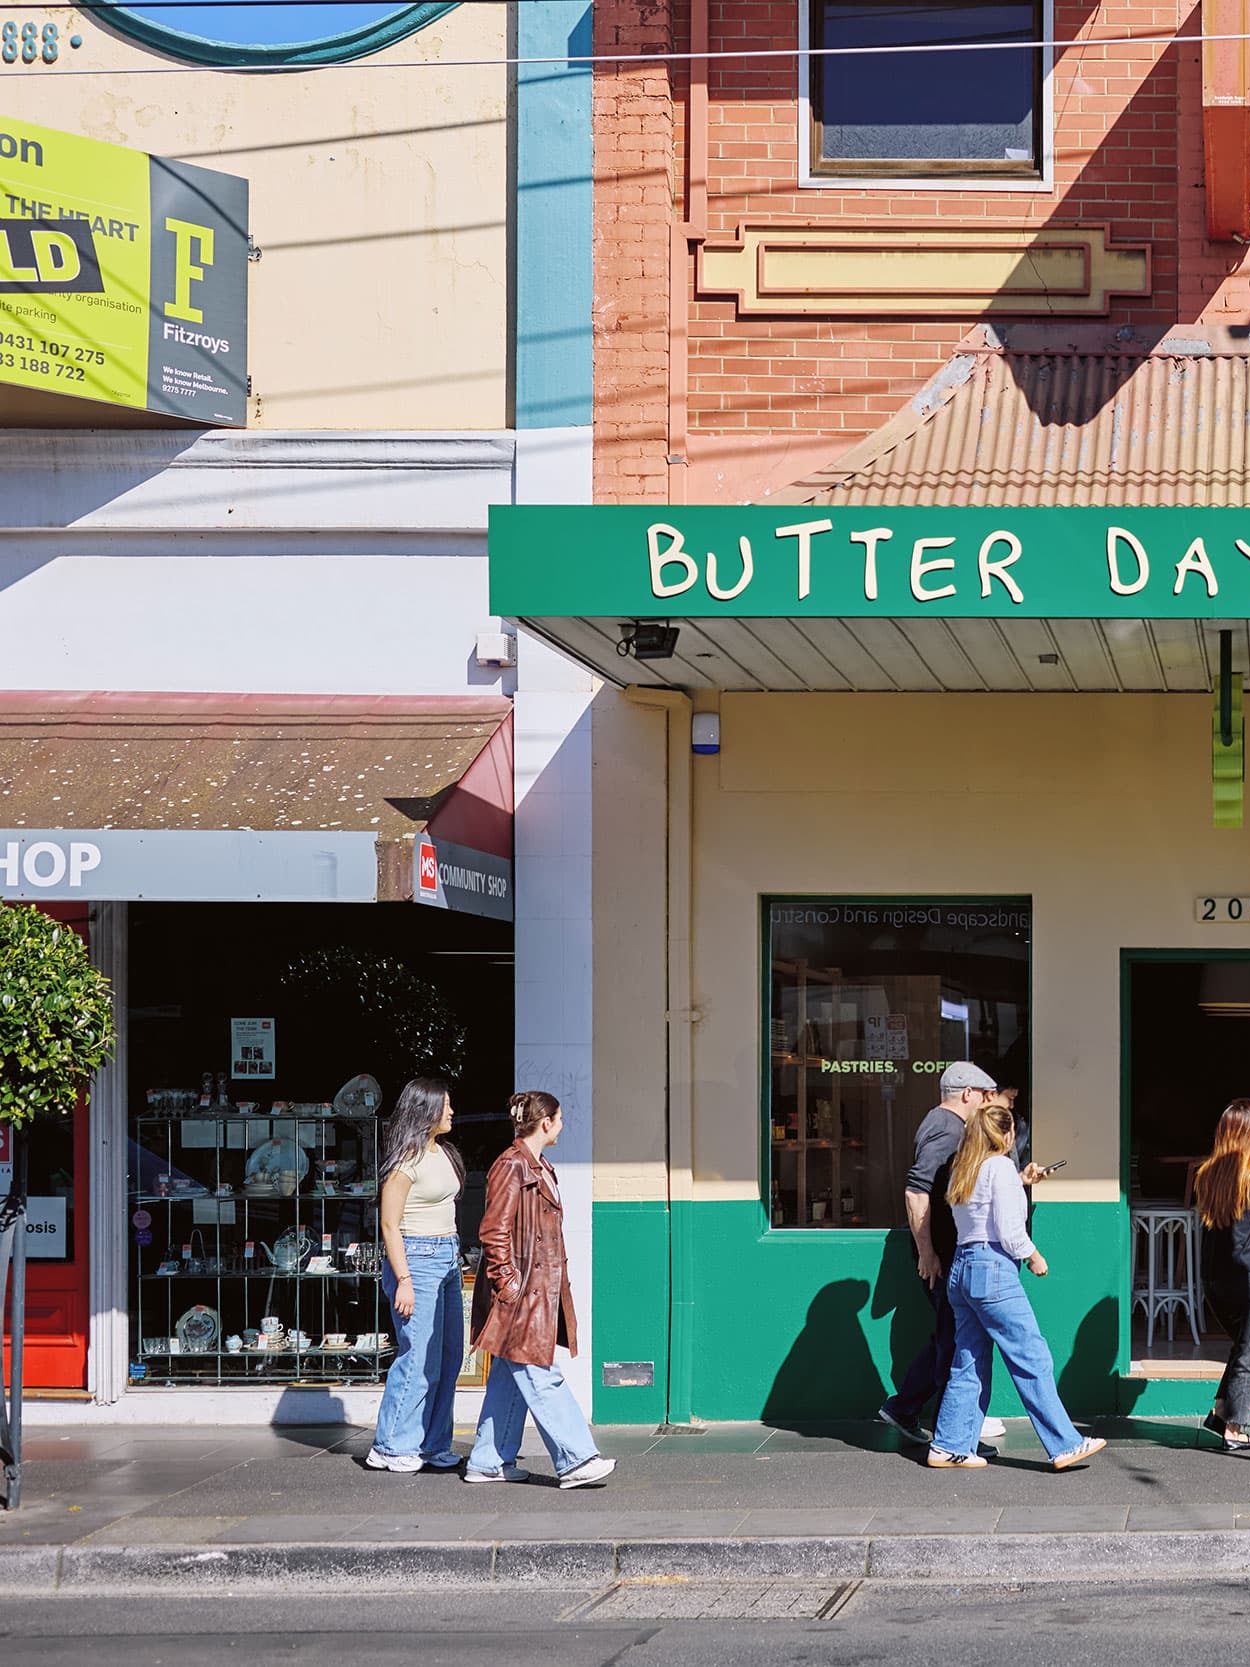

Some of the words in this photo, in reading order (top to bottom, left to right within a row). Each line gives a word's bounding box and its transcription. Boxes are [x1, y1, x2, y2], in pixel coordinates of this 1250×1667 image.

[5, 193, 52, 220] THE
[15, 305, 57, 324] parking
[75, 293, 142, 314] organisation
[163, 322, 230, 354] Fitzroys
[40, 340, 69, 358] 107
[75, 347, 105, 365] 275
[20, 357, 50, 375] 188
[55, 363, 85, 381] 722
[163, 366, 173, 374] We
[175, 368, 192, 377] know
[163, 375, 173, 383] We
[175, 377, 192, 387] know
[193, 381, 229, 395] Melbourne.
[646, 519, 1024, 603] BUTTER
[421, 856, 435, 878] MS
[438, 863, 486, 893] COMMUNITY
[488, 875, 507, 898] SHOP
[821, 1060, 898, 1073] PASTRIES.
[912, 1060, 962, 1073] COFF
